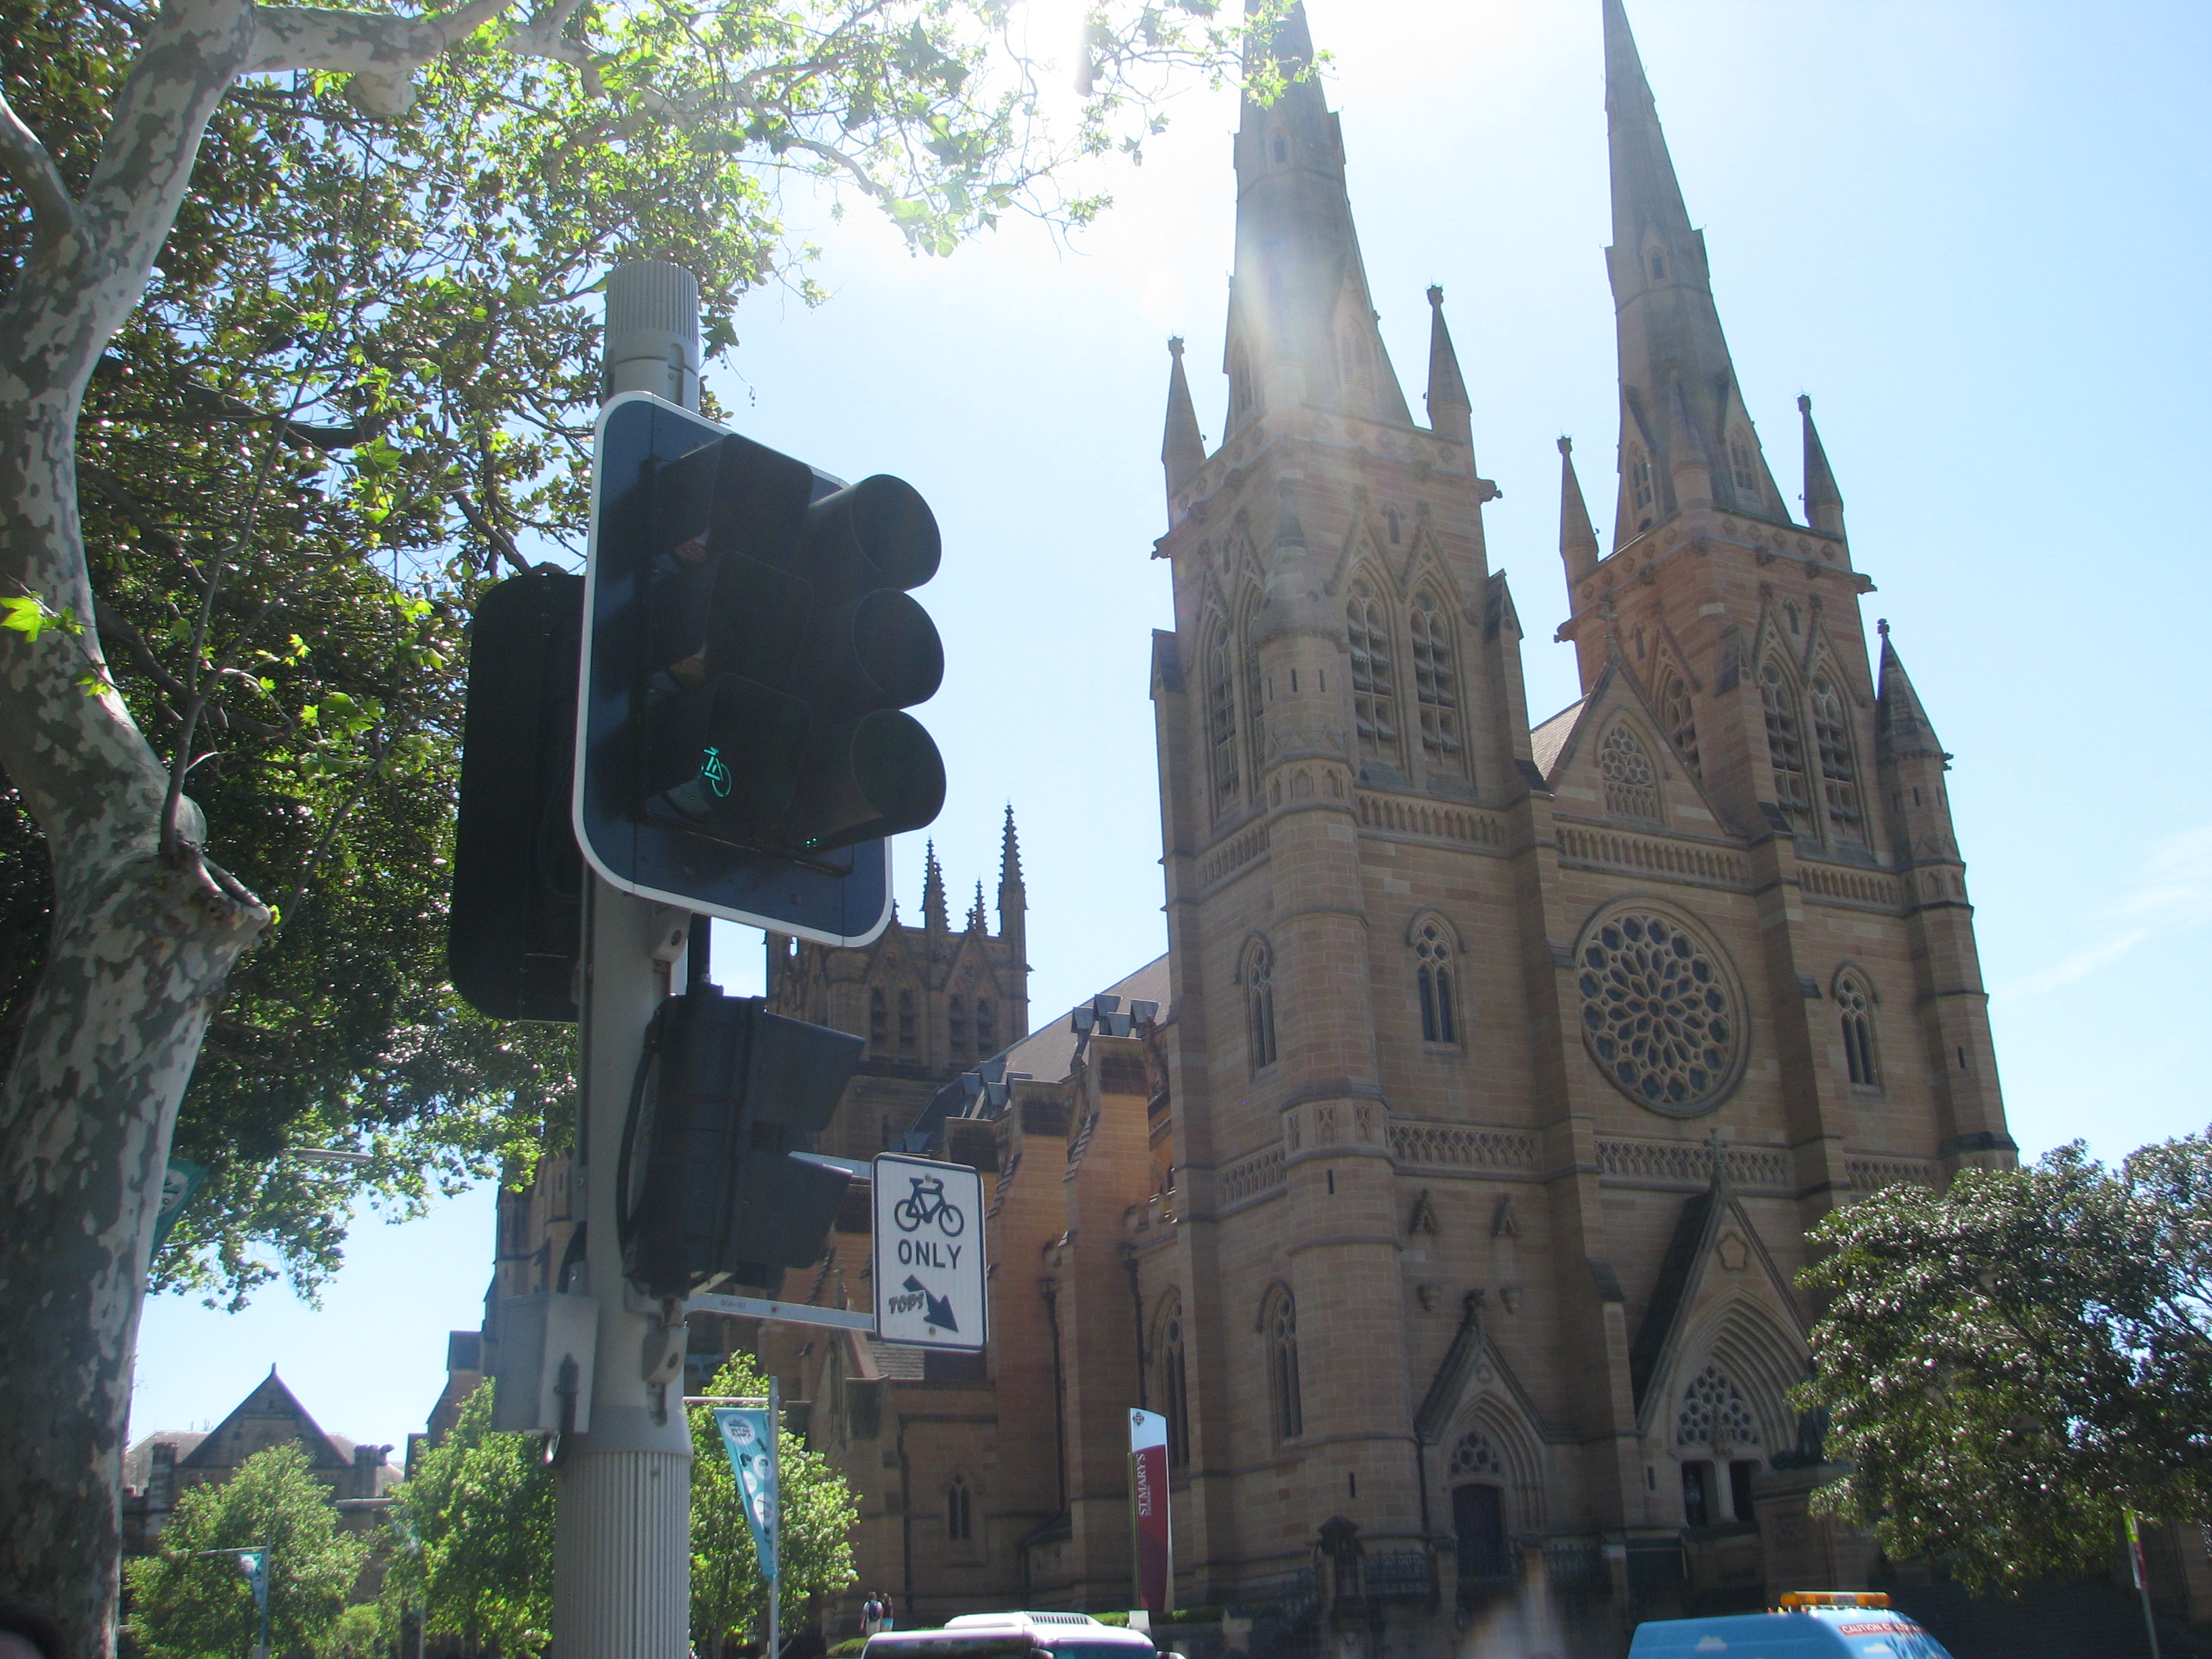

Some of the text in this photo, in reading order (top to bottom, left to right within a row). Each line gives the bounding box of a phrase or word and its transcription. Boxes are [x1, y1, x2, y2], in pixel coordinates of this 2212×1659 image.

[899, 1239, 962, 1269] ONLY
[1136, 1454, 1147, 1515] ST MARY'S
[1841, 1622, 1883, 1633] CAUTION
